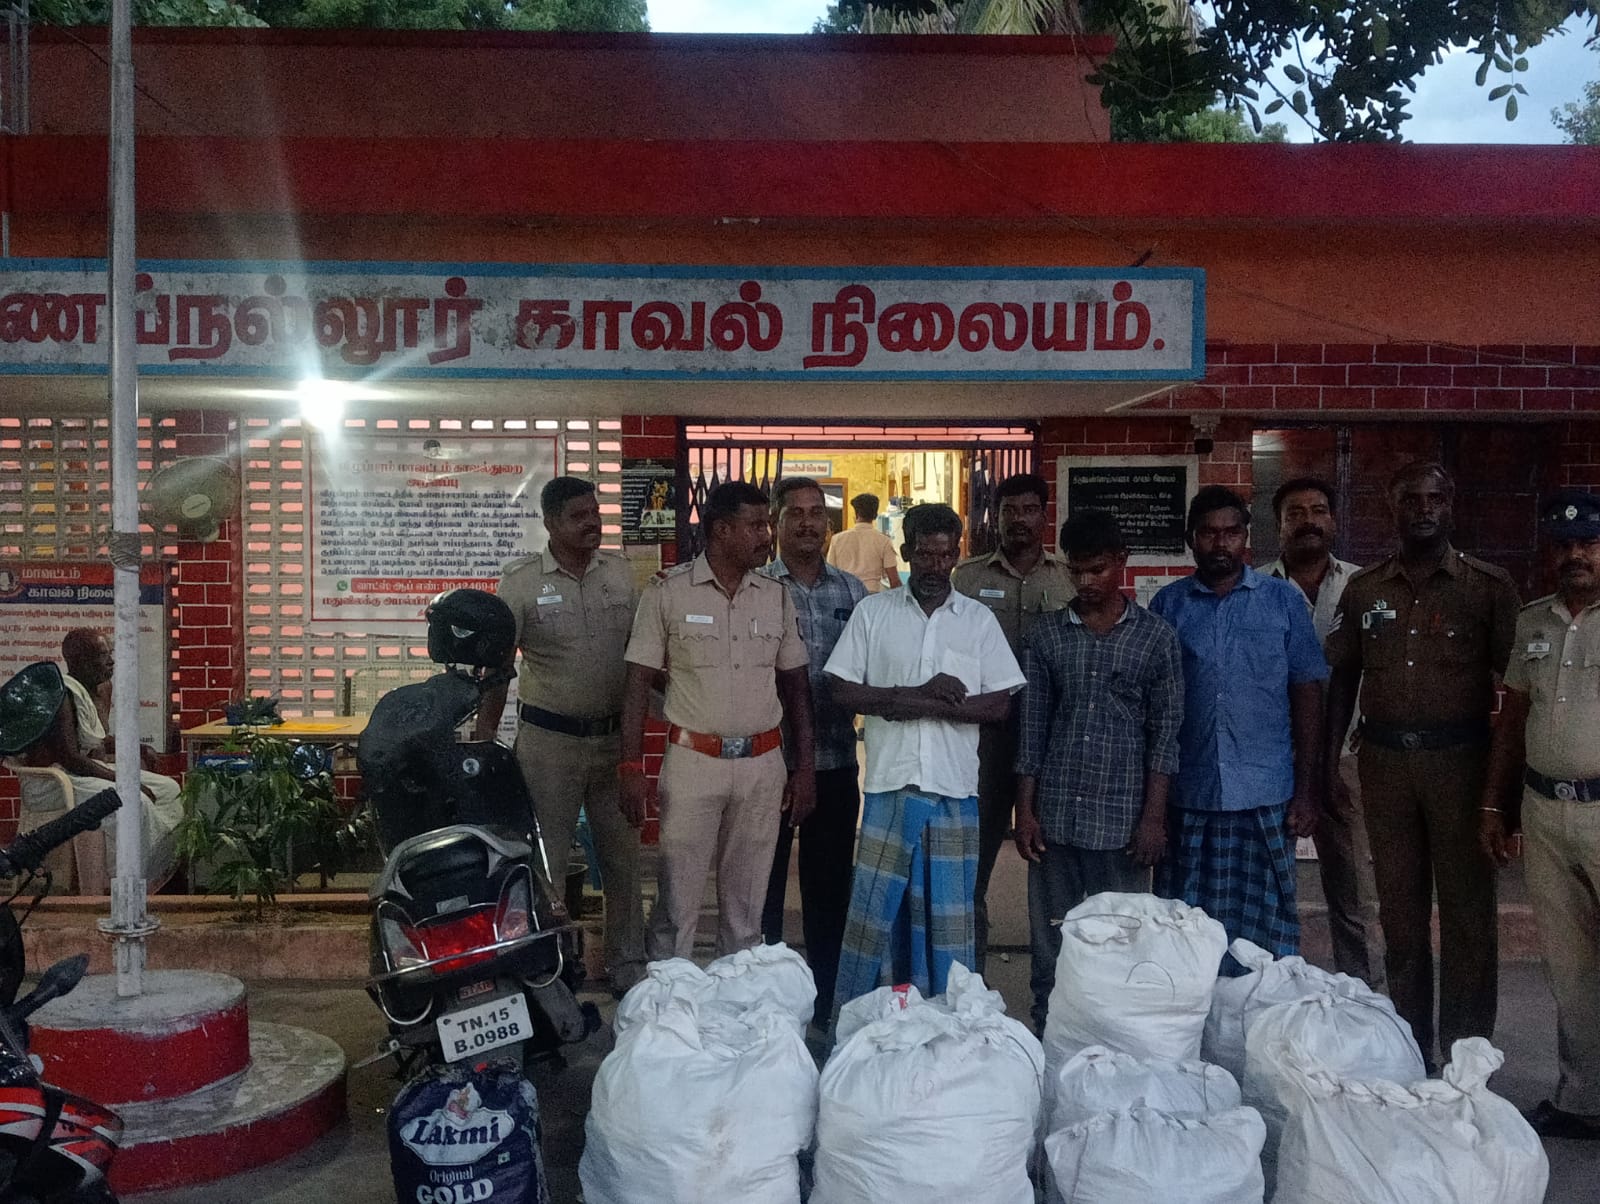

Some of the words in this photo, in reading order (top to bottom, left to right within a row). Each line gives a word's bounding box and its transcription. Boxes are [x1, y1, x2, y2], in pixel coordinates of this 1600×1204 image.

[515, 280, 783, 352] காவல்
[803, 281, 1166, 369] நிலையம்.
[22, 566, 81, 579] மாவட்டம்
[27, 585, 74, 598] காவல்
[457, 1007, 510, 1034] TN.15
[454, 1022, 520, 1054] B.0988
[429, 1165, 474, 1186] Original
[416, 1178, 494, 1204] GOLD
